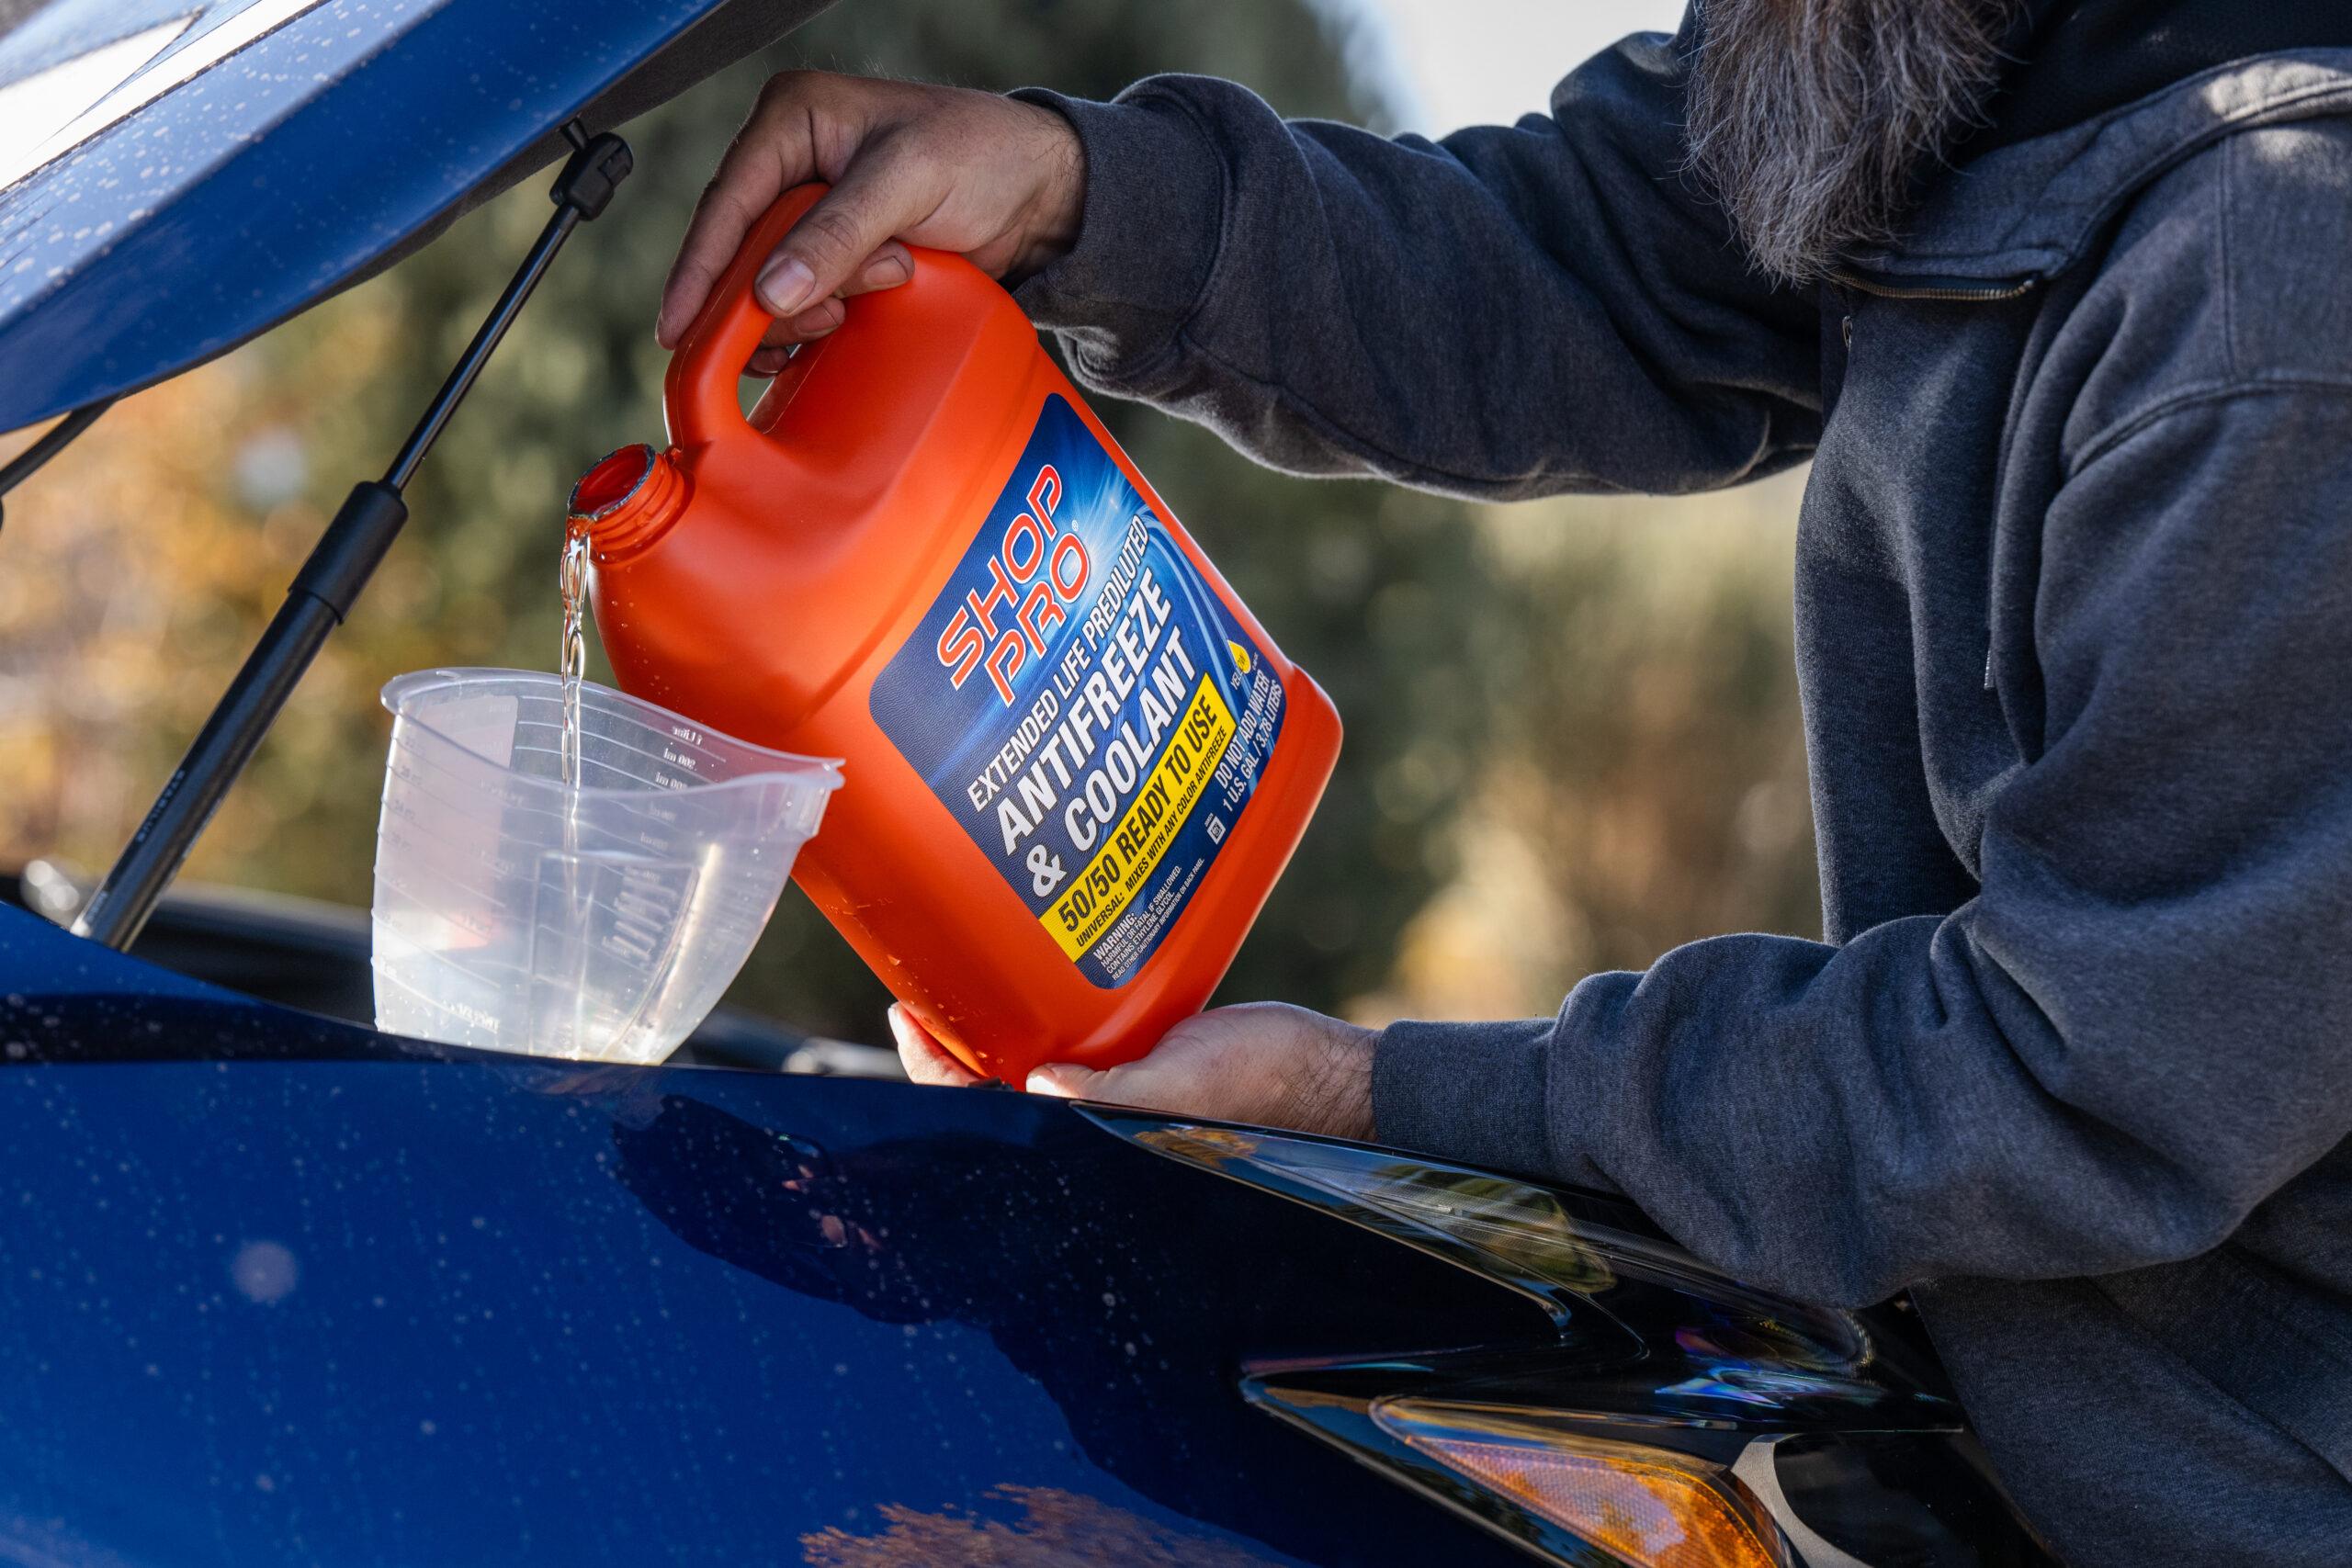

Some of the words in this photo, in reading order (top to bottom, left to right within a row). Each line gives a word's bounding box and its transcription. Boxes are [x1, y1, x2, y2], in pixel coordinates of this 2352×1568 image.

[936, 464, 1062, 691] SHOP
[984, 533, 1090, 709] PRO
[967, 689, 1059, 812] EXTENDED
[1053, 637, 1091, 700] LIFE
[1081, 514, 1148, 652] PREDILUTED
[1263, 679, 1283, 724] LITERS
[997, 567, 1171, 855] ANTIFREEZE
[1214, 761, 1233, 789] DO
[1225, 735, 1246, 771] NOT
[1238, 710, 1258, 745] ADD
[1248, 669, 1270, 716] WATER
[1252, 740, 1262, 757] /
[1255, 719, 1273, 749] 3.78
[1026, 844, 1067, 897] &
[1065, 626, 1195, 852] COOLANT
[1227, 776, 1248, 804] U.S.
[1240, 752, 1259, 780] GAL
[1057, 853, 1121, 932] 50/50
[1115, 773, 1171, 864] READY
[1164, 743, 1191, 786] TO
[1183, 694, 1217, 753] USE
[1076, 892, 1125, 947] UNIVERSAL:
[1125, 857, 1149, 893] MIXES
[1148, 833, 1166, 864] WITH
[1165, 811, 1179, 835] ANY
[1176, 783, 1198, 816] COLOR
[1195, 726, 1227, 784] ANTIFREEZE
[1223, 798, 1234, 813] 1
[1093, 912, 1137, 961] WARNING:
[1101, 939, 1129, 968] HARMFUL
[1126, 929, 1137, 940] OR
[1135, 910, 1151, 931] FATAL
[1148, 903, 1155, 913] IF
[1153, 865, 1182, 905] SWALLOWED.
[1106, 943, 1135, 975] CONTAINS
[1132, 913, 1159, 945] ETHYLENE
[1112, 967, 1126, 981] READ
[1125, 952, 1139, 969] OTHER
